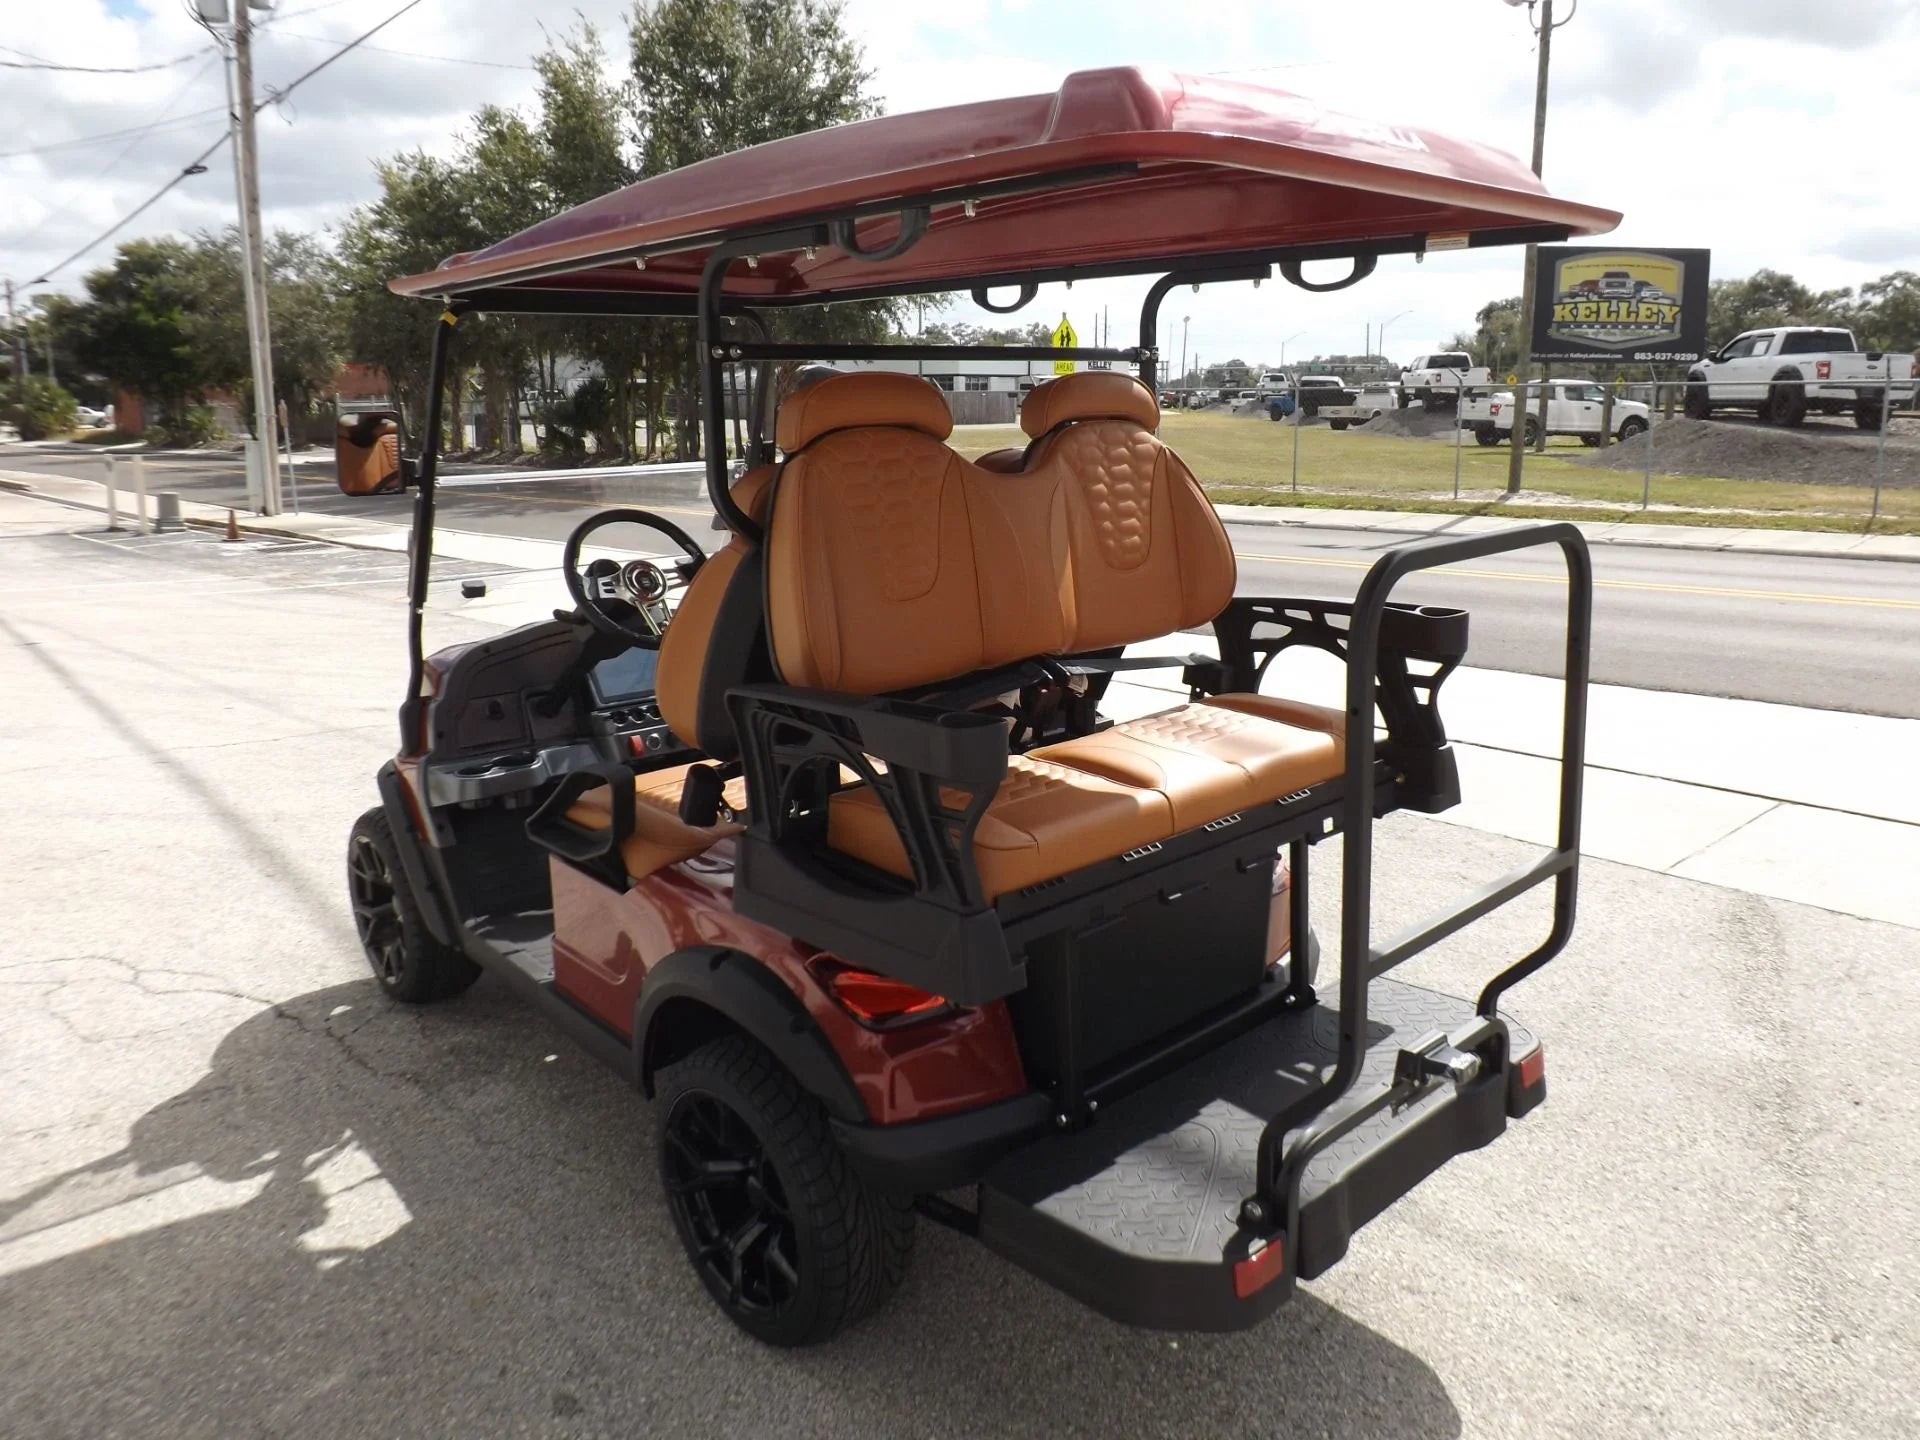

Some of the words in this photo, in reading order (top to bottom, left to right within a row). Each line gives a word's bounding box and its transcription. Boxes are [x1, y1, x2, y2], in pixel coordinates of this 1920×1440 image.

[1553, 301, 1682, 323] KELLEY
[1056, 362, 1074, 371] AHEAD
[1088, 360, 1112, 369] KELLEY
